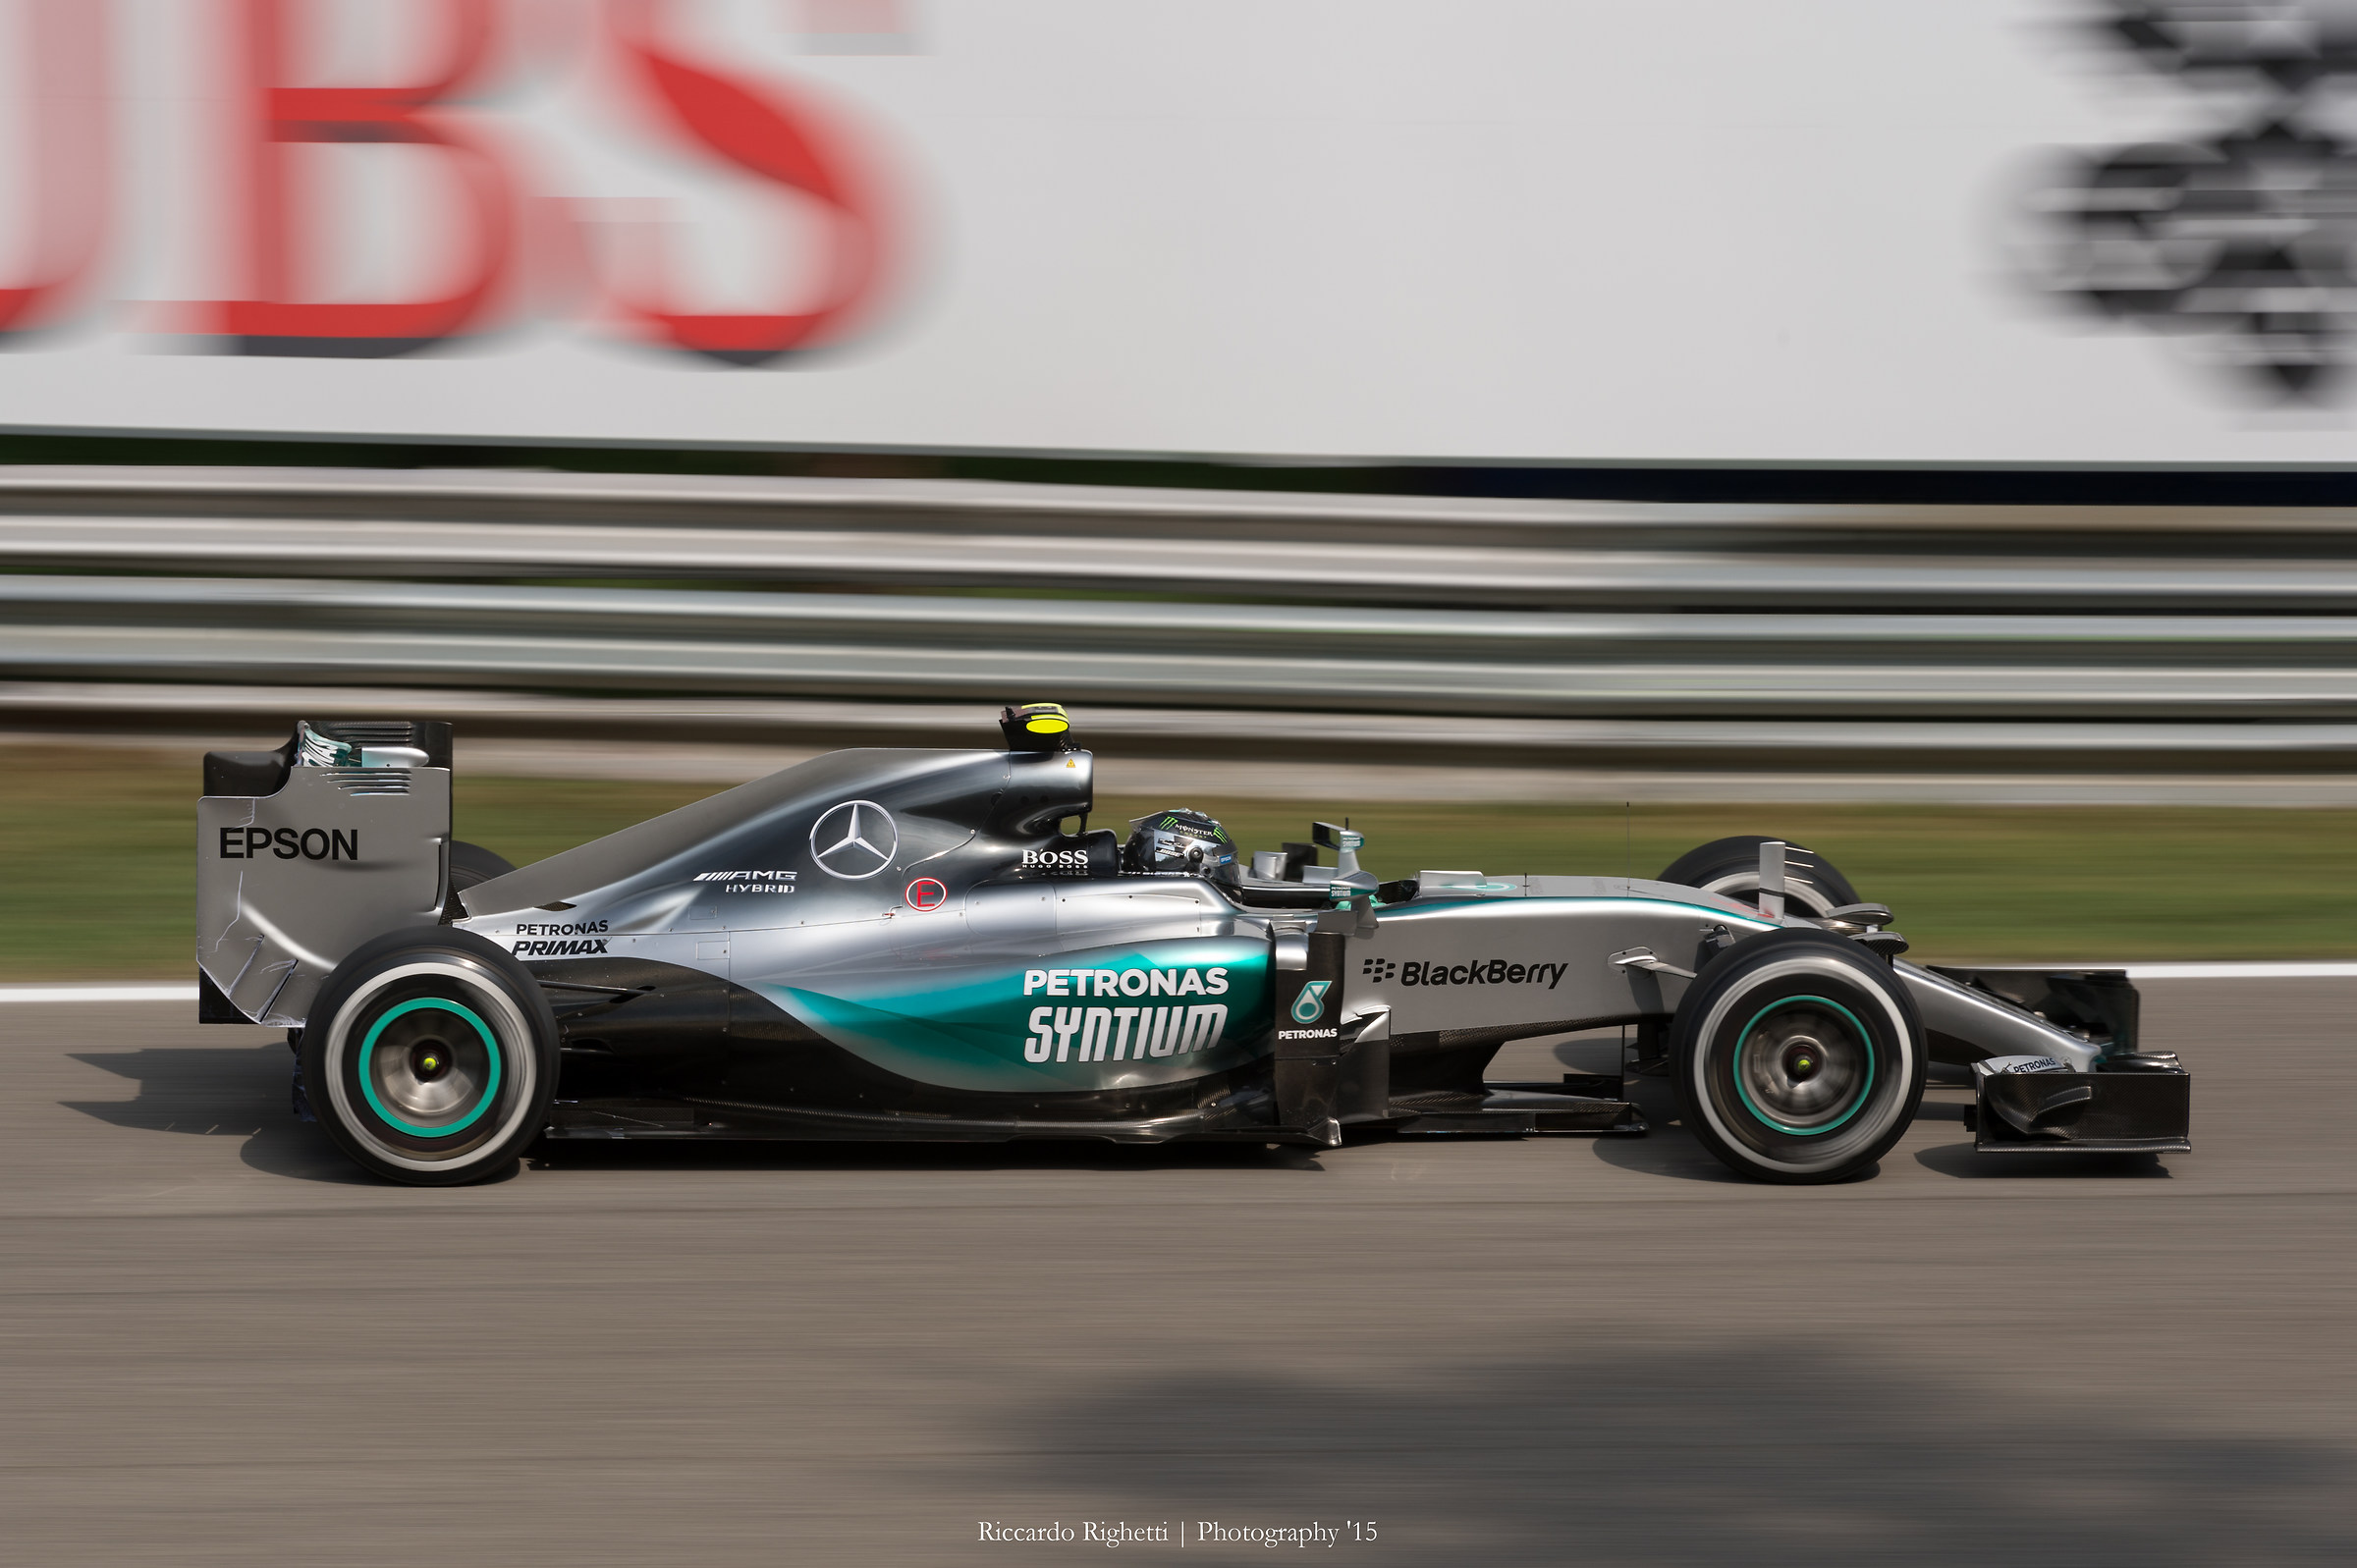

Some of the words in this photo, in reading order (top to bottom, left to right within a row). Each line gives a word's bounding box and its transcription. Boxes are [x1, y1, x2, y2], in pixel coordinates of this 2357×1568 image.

[219, 827, 358, 861] EPSON
[1021, 849, 1088, 864] BOSS
[725, 884, 795, 893] HYBRID
[516, 919, 609, 936] PETRONAS
[511, 939, 609, 956] PRIMAX
[1023, 967, 1229, 997] PETRONAS
[1401, 959, 1568, 990] BlackBerry
[1023, 1003, 1229, 1063] SYNTIUM
[1278, 1028, 1338, 1041] PETRONAS
[2013, 1057, 2056, 1073] PETRONAS
